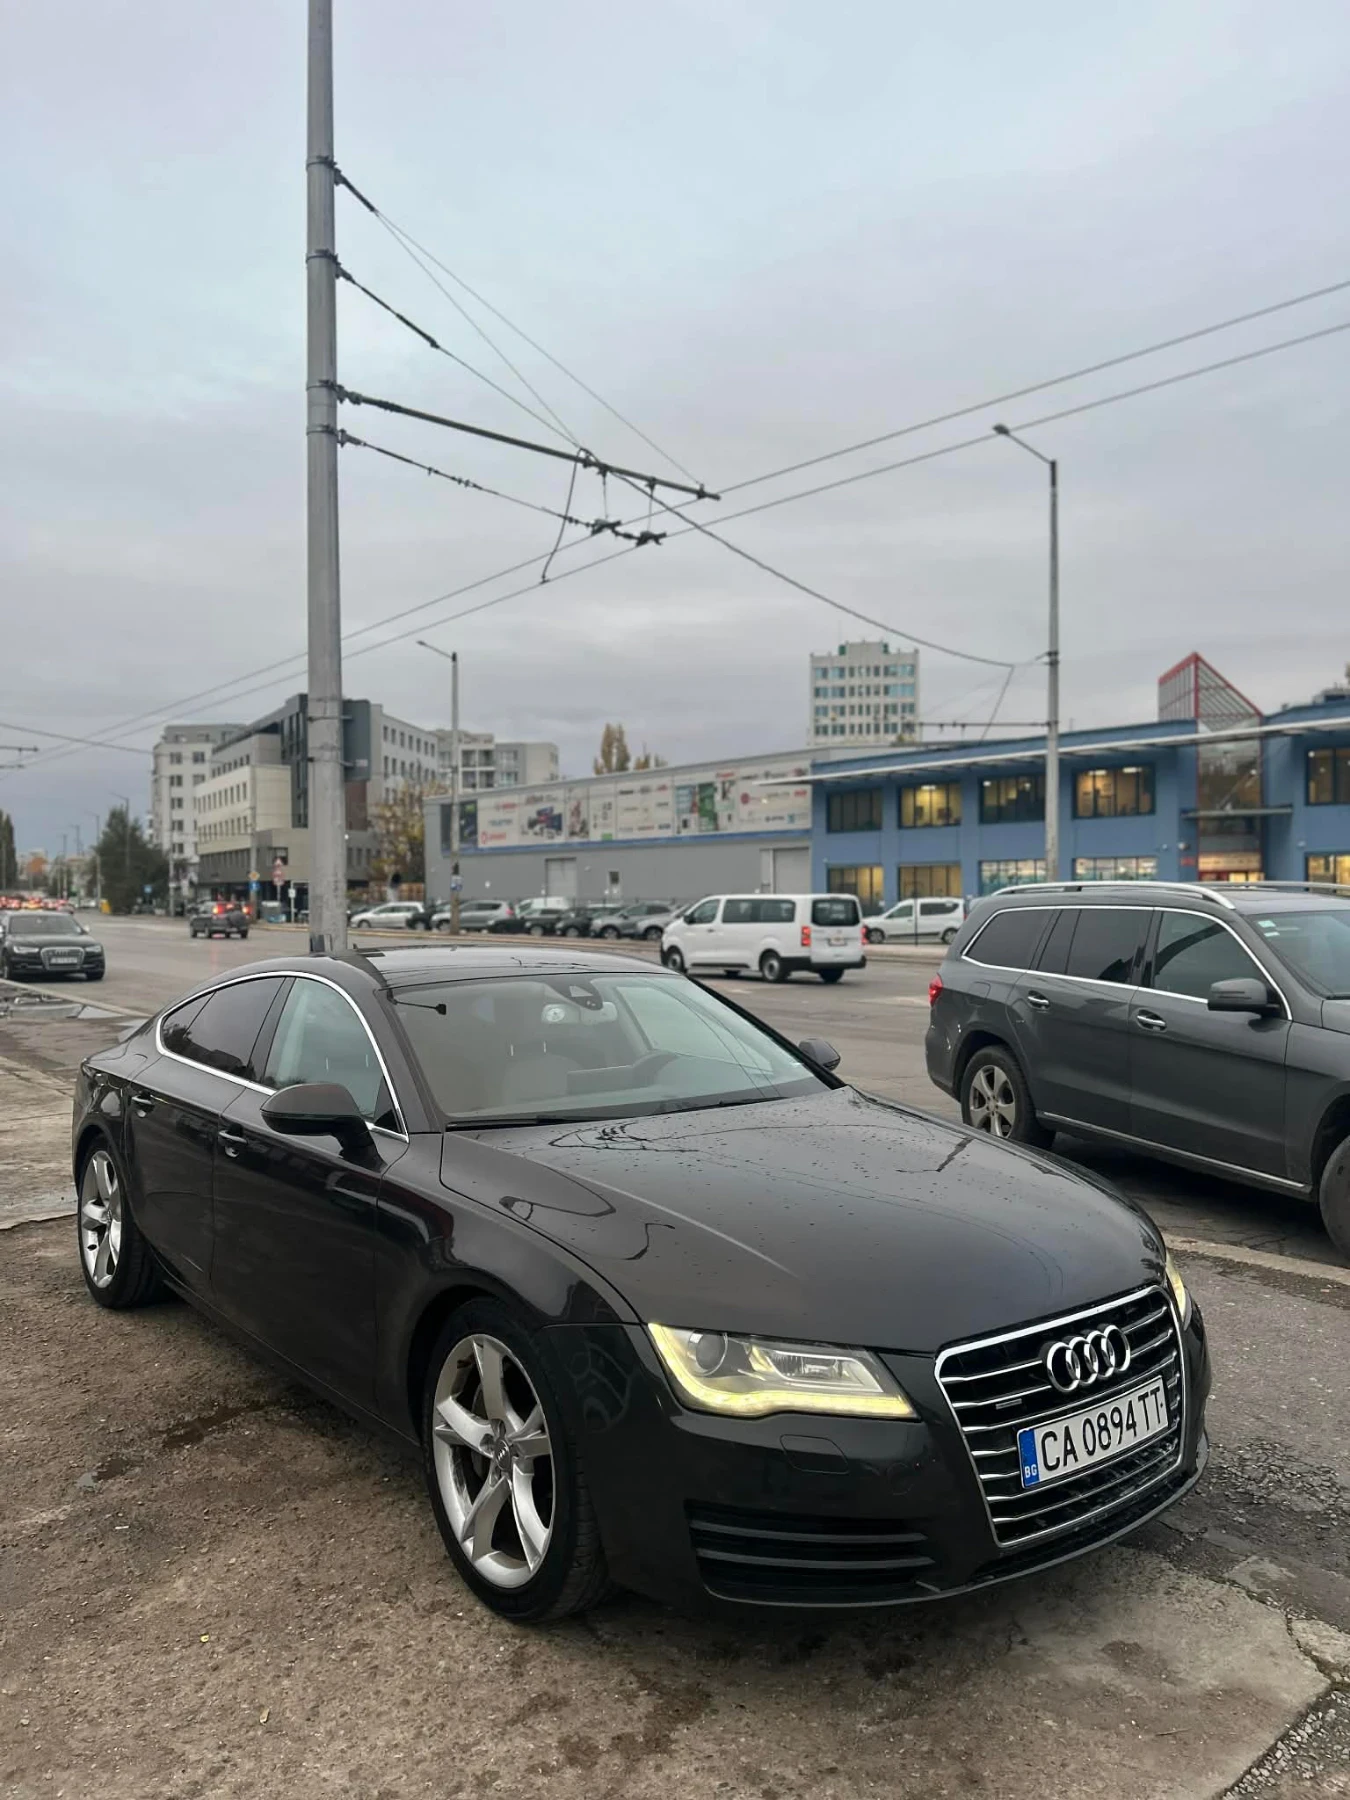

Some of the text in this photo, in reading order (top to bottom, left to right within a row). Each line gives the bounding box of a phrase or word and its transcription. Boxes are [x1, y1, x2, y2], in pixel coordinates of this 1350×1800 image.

[1041, 1386, 1161, 1471] CA 0894 TT
[1024, 1464, 1038, 1479] BG
